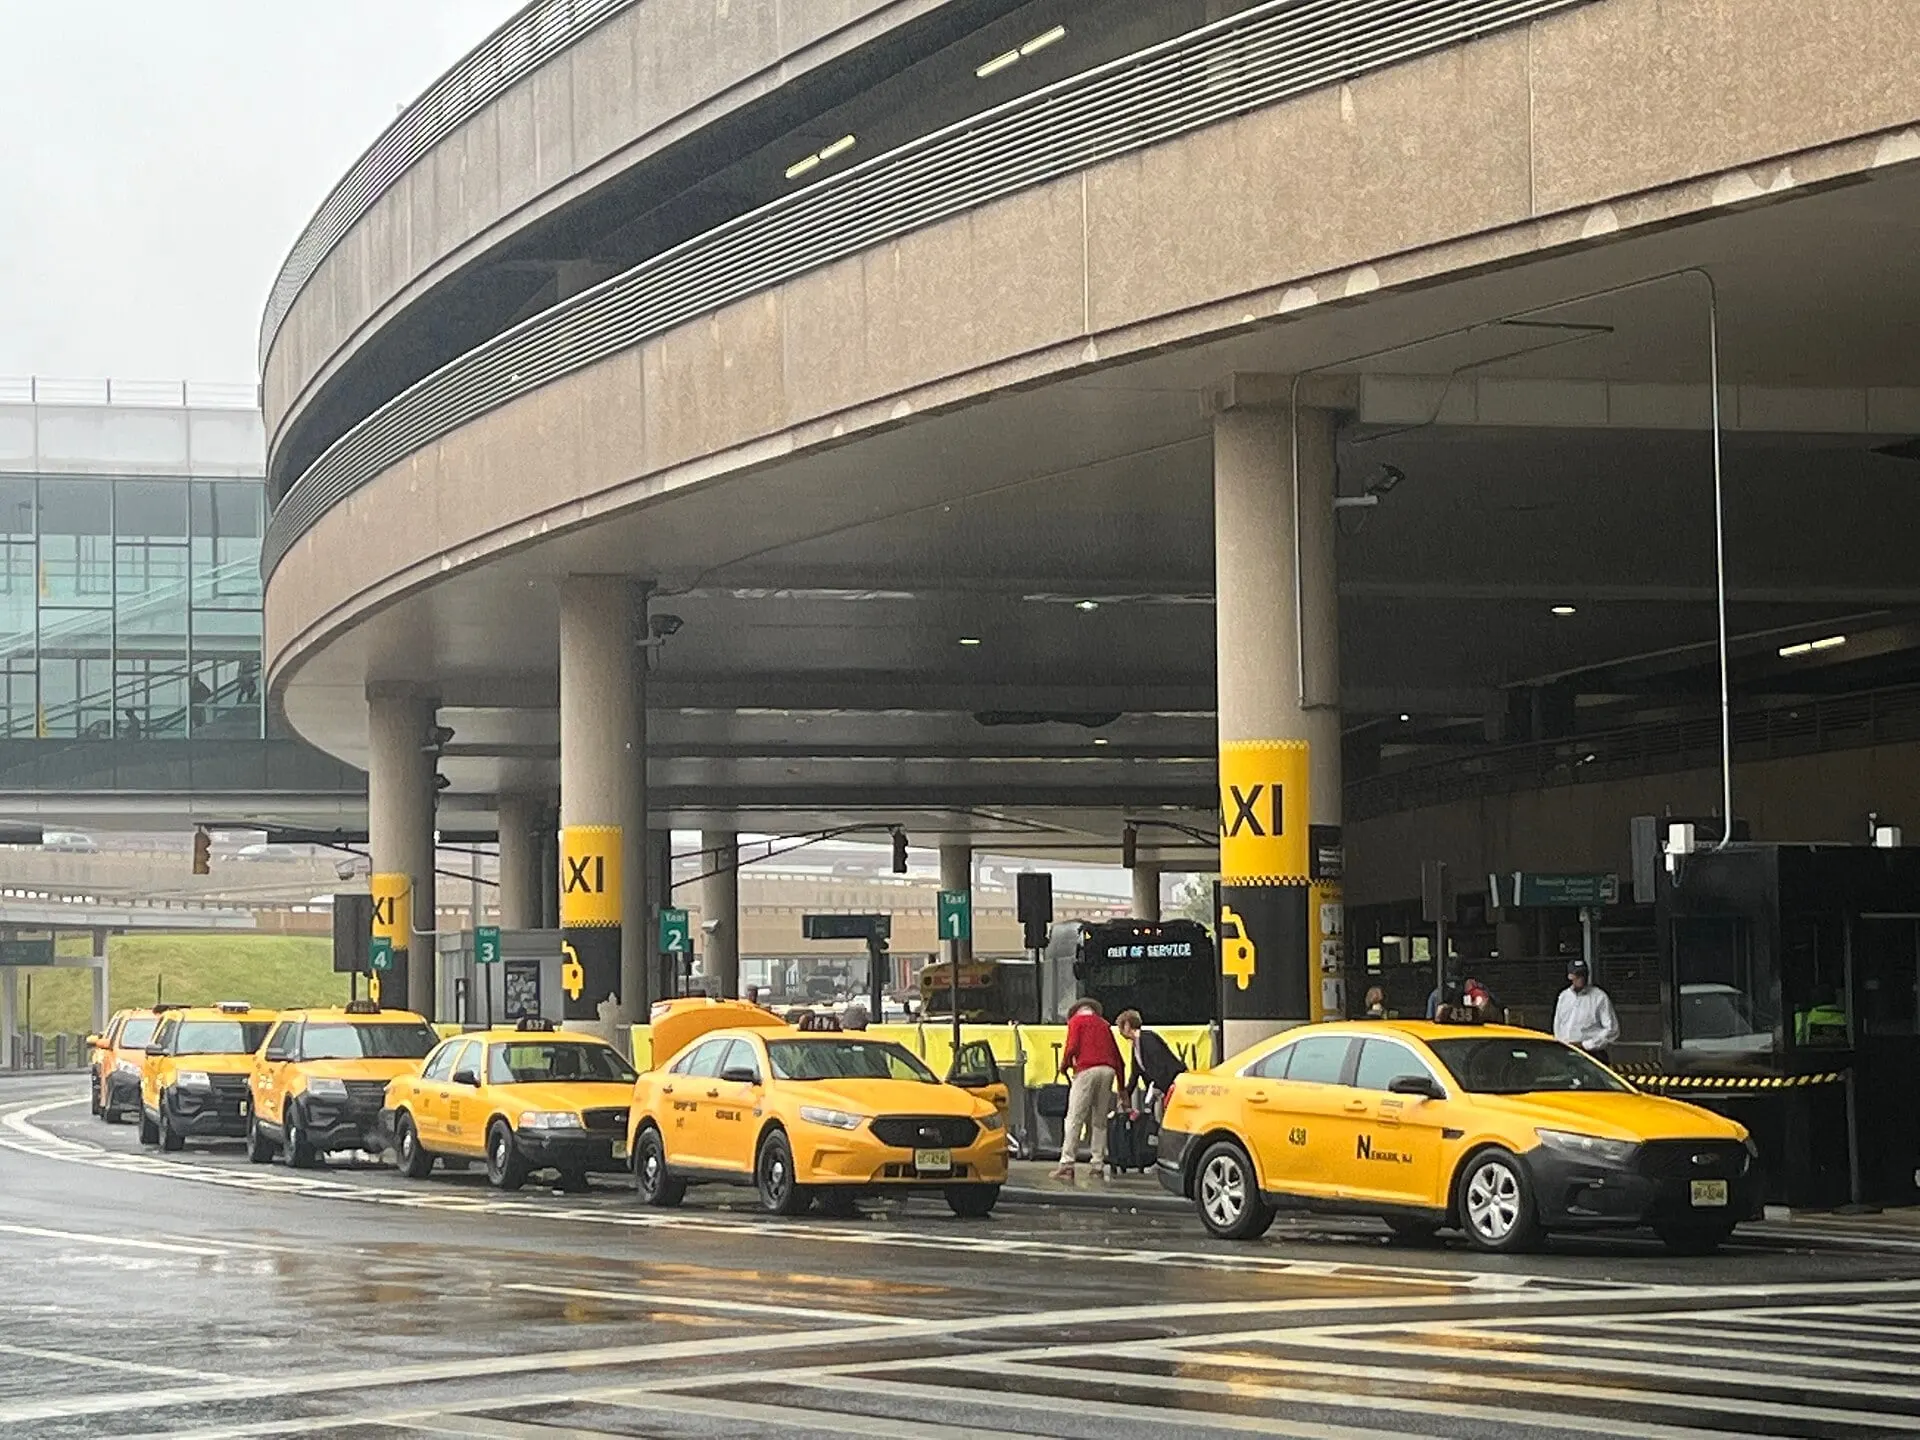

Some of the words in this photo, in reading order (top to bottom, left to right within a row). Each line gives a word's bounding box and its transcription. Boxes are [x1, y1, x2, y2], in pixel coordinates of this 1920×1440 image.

[1220, 784, 1284, 837] XI
[562, 856, 604, 893] XI
[943, 894, 966, 904] Taxi
[948, 913, 960, 937] 1
[667, 929, 683, 951] 2
[374, 950, 387, 968] 4
[481, 943, 494, 962] 3
[1107, 946, 1128, 958] OUT
[1130, 945, 1145, 958] OF
[1147, 943, 1192, 958] SERVICE
